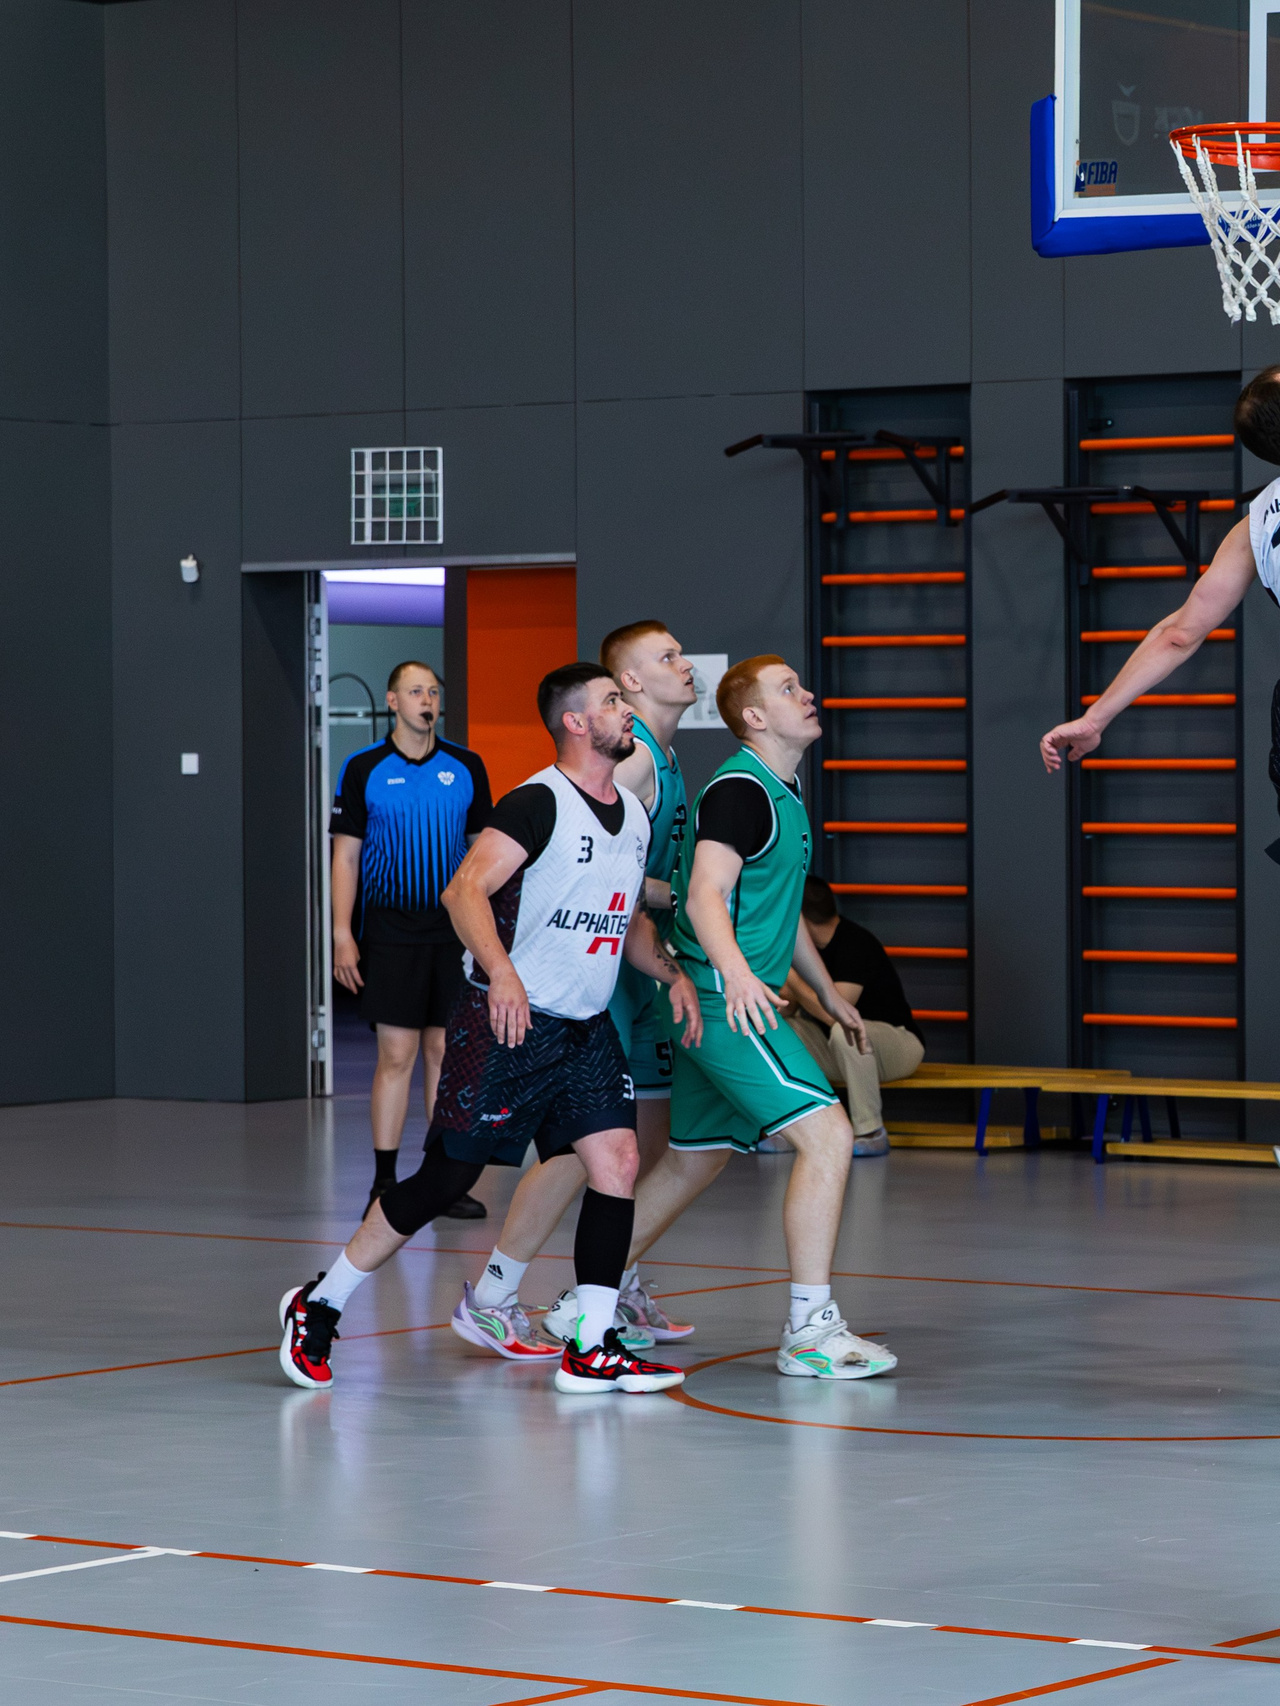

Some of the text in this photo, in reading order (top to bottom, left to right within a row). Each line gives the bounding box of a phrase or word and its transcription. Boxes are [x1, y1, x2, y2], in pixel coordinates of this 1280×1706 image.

[1086, 161, 1118, 185] FIBA
[577, 835, 594, 863] 3
[622, 1073, 635, 1101] 3
